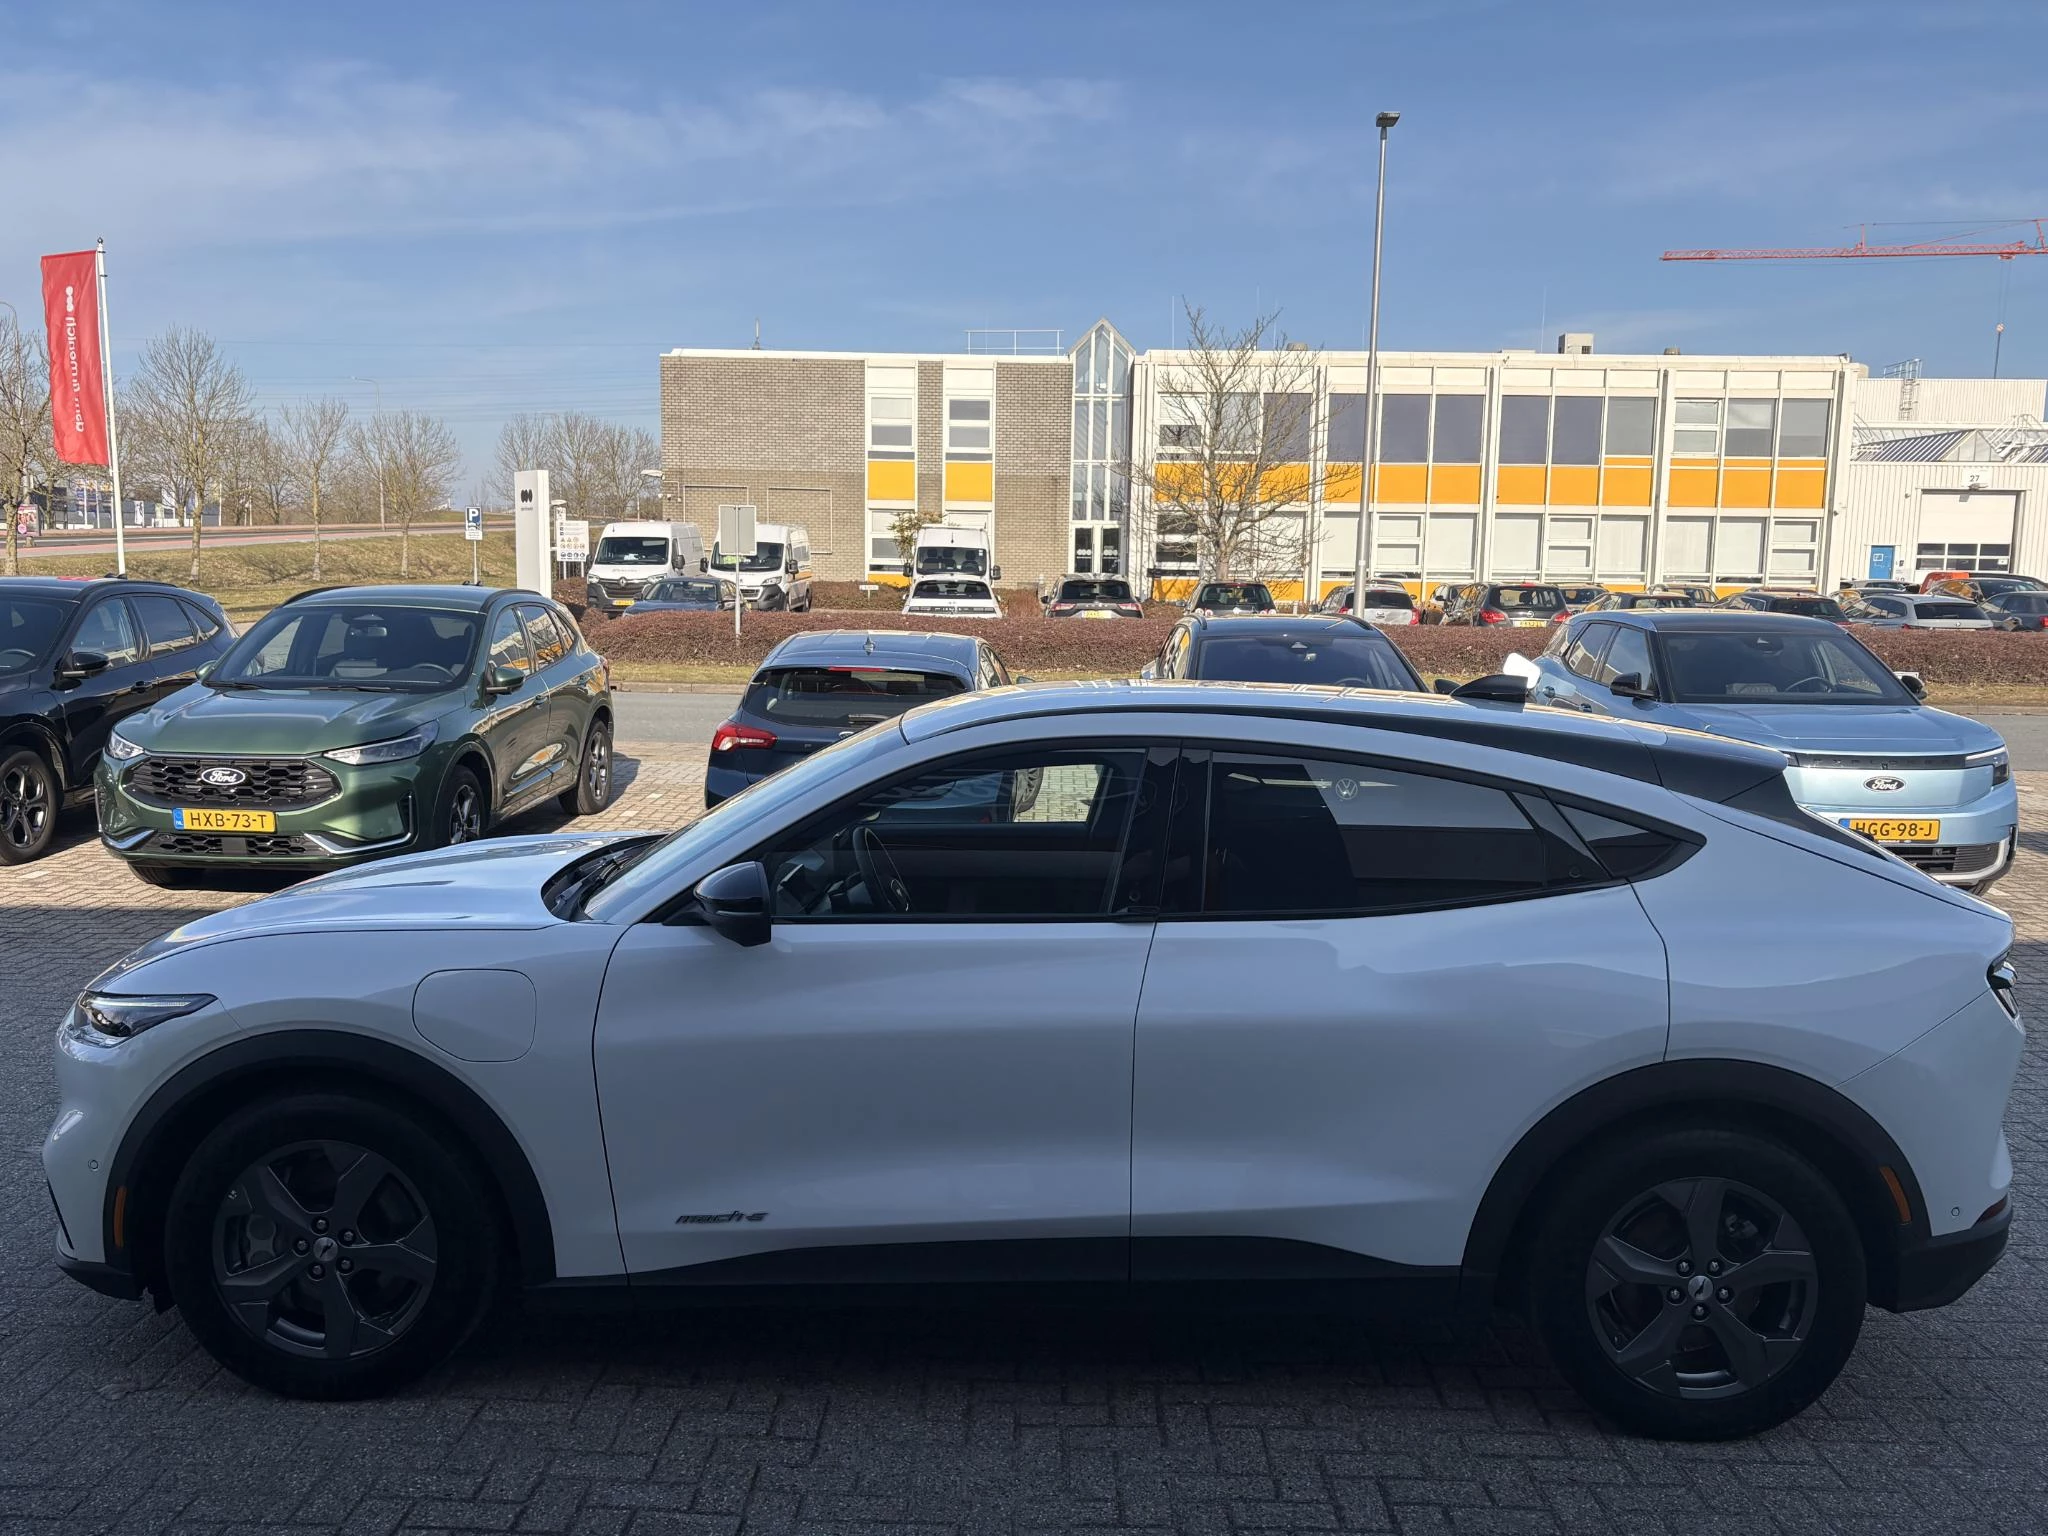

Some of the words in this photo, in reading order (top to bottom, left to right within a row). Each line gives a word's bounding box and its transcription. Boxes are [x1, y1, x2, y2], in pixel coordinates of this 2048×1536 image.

[1969, 474, 1980, 483] 27
[468, 508, 479, 521] P
[209, 768, 238, 785] Ford
[1871, 778, 1899, 791] Ford
[190, 812, 267, 829] HXB-73-T
[1855, 822, 1933, 837] HGG-98-J
